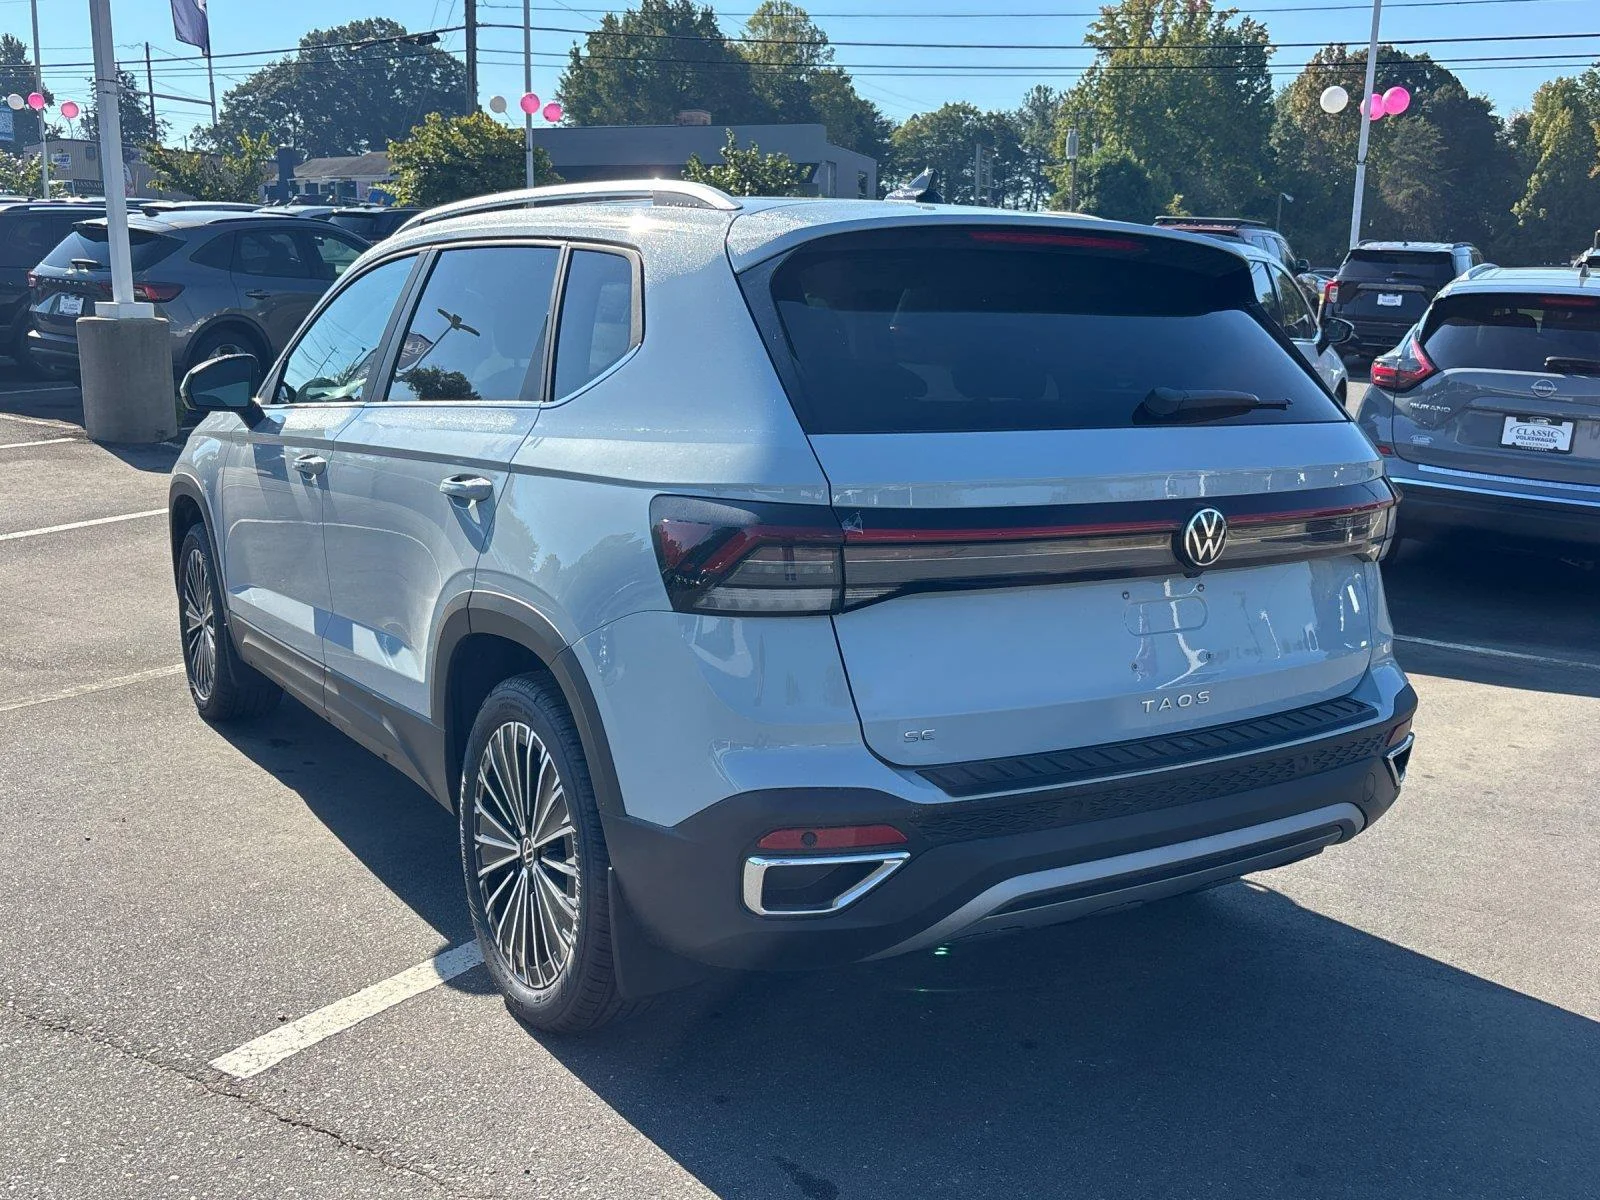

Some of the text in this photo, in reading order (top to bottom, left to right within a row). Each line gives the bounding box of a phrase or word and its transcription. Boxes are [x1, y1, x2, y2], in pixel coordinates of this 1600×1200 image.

[1515, 434, 1558, 444] VOLKSWAGEN
[1516, 427, 1558, 439] CLASSIC
[1141, 690, 1211, 713] TAOS
[903, 729, 936, 743] SE
